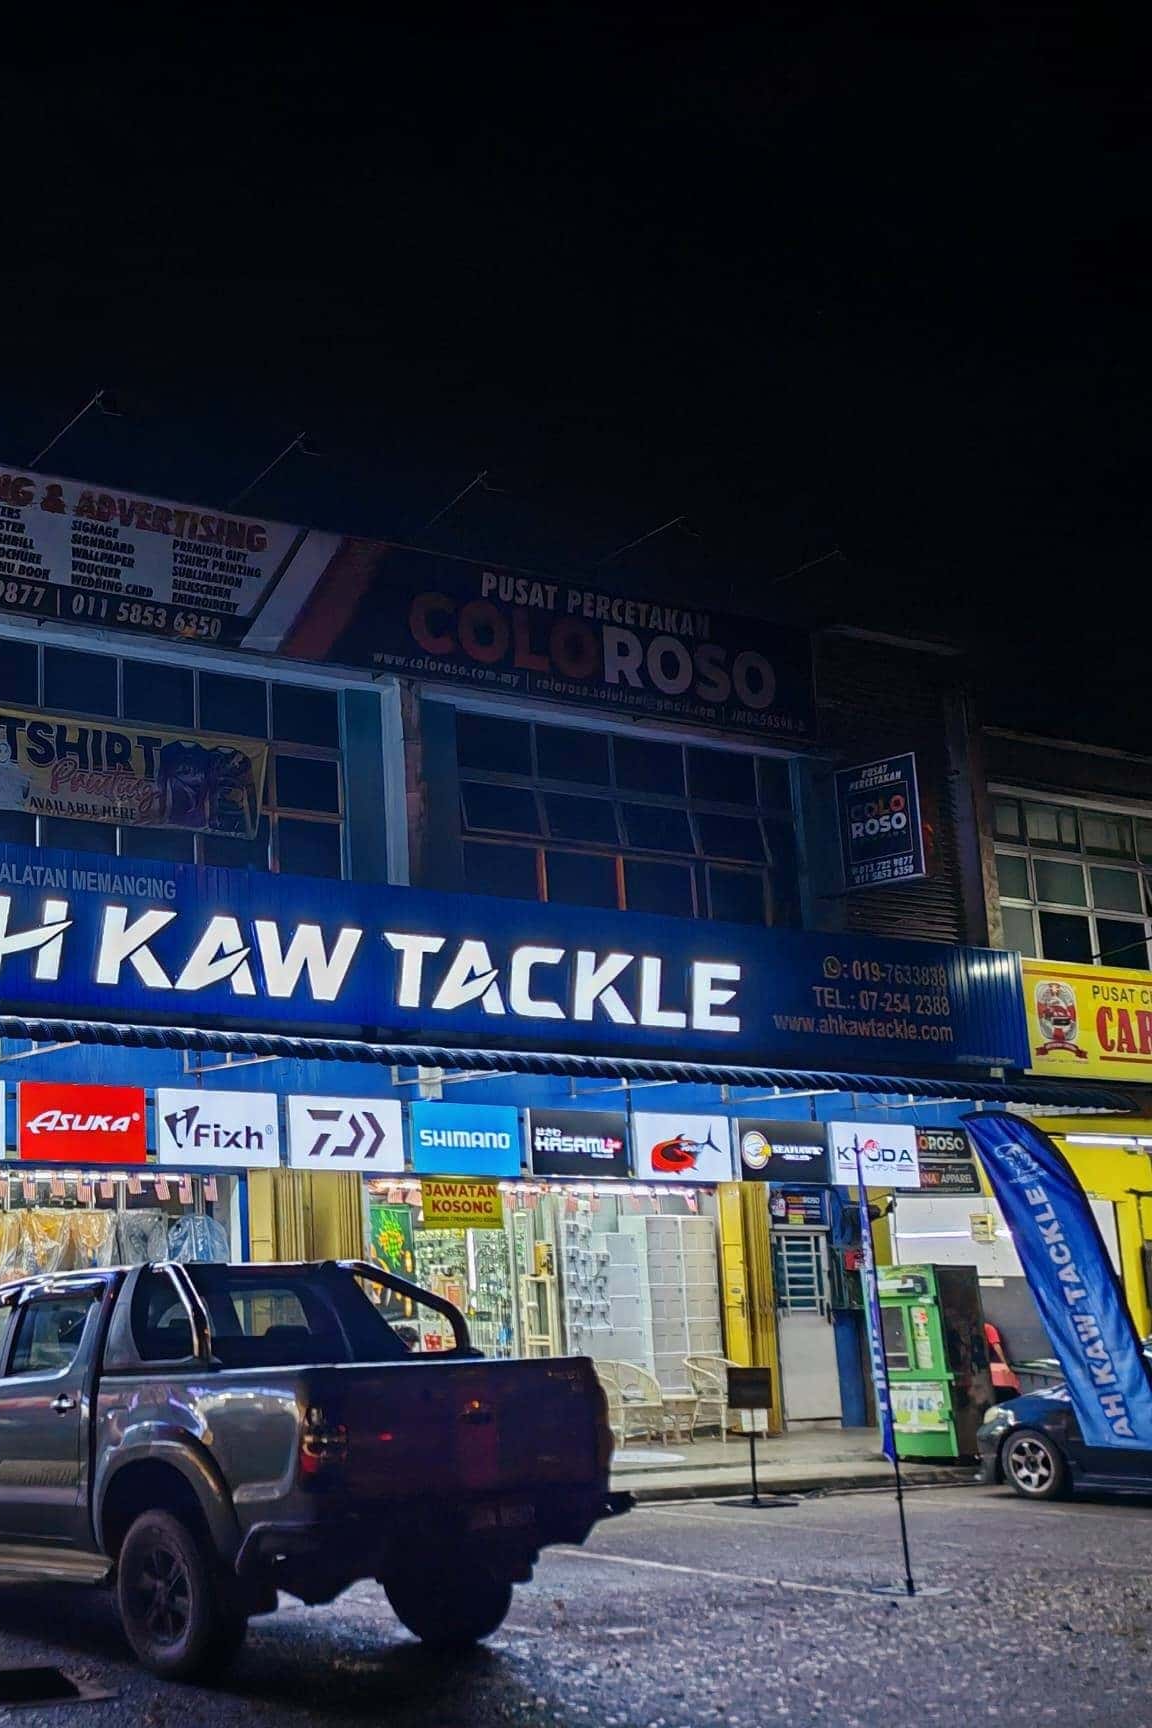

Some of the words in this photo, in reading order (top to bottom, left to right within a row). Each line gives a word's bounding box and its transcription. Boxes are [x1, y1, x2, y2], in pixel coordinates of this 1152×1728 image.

[41, 484, 65, 514] &
[74, 490, 268, 552] ADVERTISING
[71, 520, 119, 538] SIGNAGE
[70, 534, 135, 554] SIGNBOARD
[172, 539, 223, 559] PREMIUM
[225, 549, 248, 563] GIFT
[71, 547, 135, 568] WALLPAPER
[173, 553, 209, 571] TSHIRT
[211, 561, 262, 578] PRINTING
[18, 565, 50, 580] BOOK
[71, 560, 121, 580] VOUCHER
[172, 566, 243, 589] SUBLIMATION
[71, 574, 123, 593] WEDDING
[71, 593, 107, 618] 011
[116, 602, 168, 628] 5853
[173, 611, 222, 640] 6350
[481, 572, 559, 610] PUSAT
[567, 592, 711, 640] PERCETAKAN
[408, 592, 778, 711] COLOROSO
[30, 796, 98, 816] AVAILABLE
[102, 806, 137, 820] HERE
[851, 811, 907, 839] ROSO
[72, 870, 177, 900] MEMANCING
[96, 905, 363, 1001] KAW
[384, 931, 741, 1032] TACKLE
[1092, 985, 1137, 1003] PUSAT
[773, 1012, 954, 1043] www.ahkawtackle.com
[194, 1123, 264, 1150] Fixh
[420, 1128, 511, 1149] SHIMANO
[919, 1135, 965, 1151] OROSO
[425, 1183, 497, 1198] JAWATAN
[432, 1199, 493, 1214] KOSONG
[1025, 1184, 1087, 1307] TACKLE
[1072, 1314, 1118, 1386] KAW
[1099, 1392, 1136, 1437] AH
